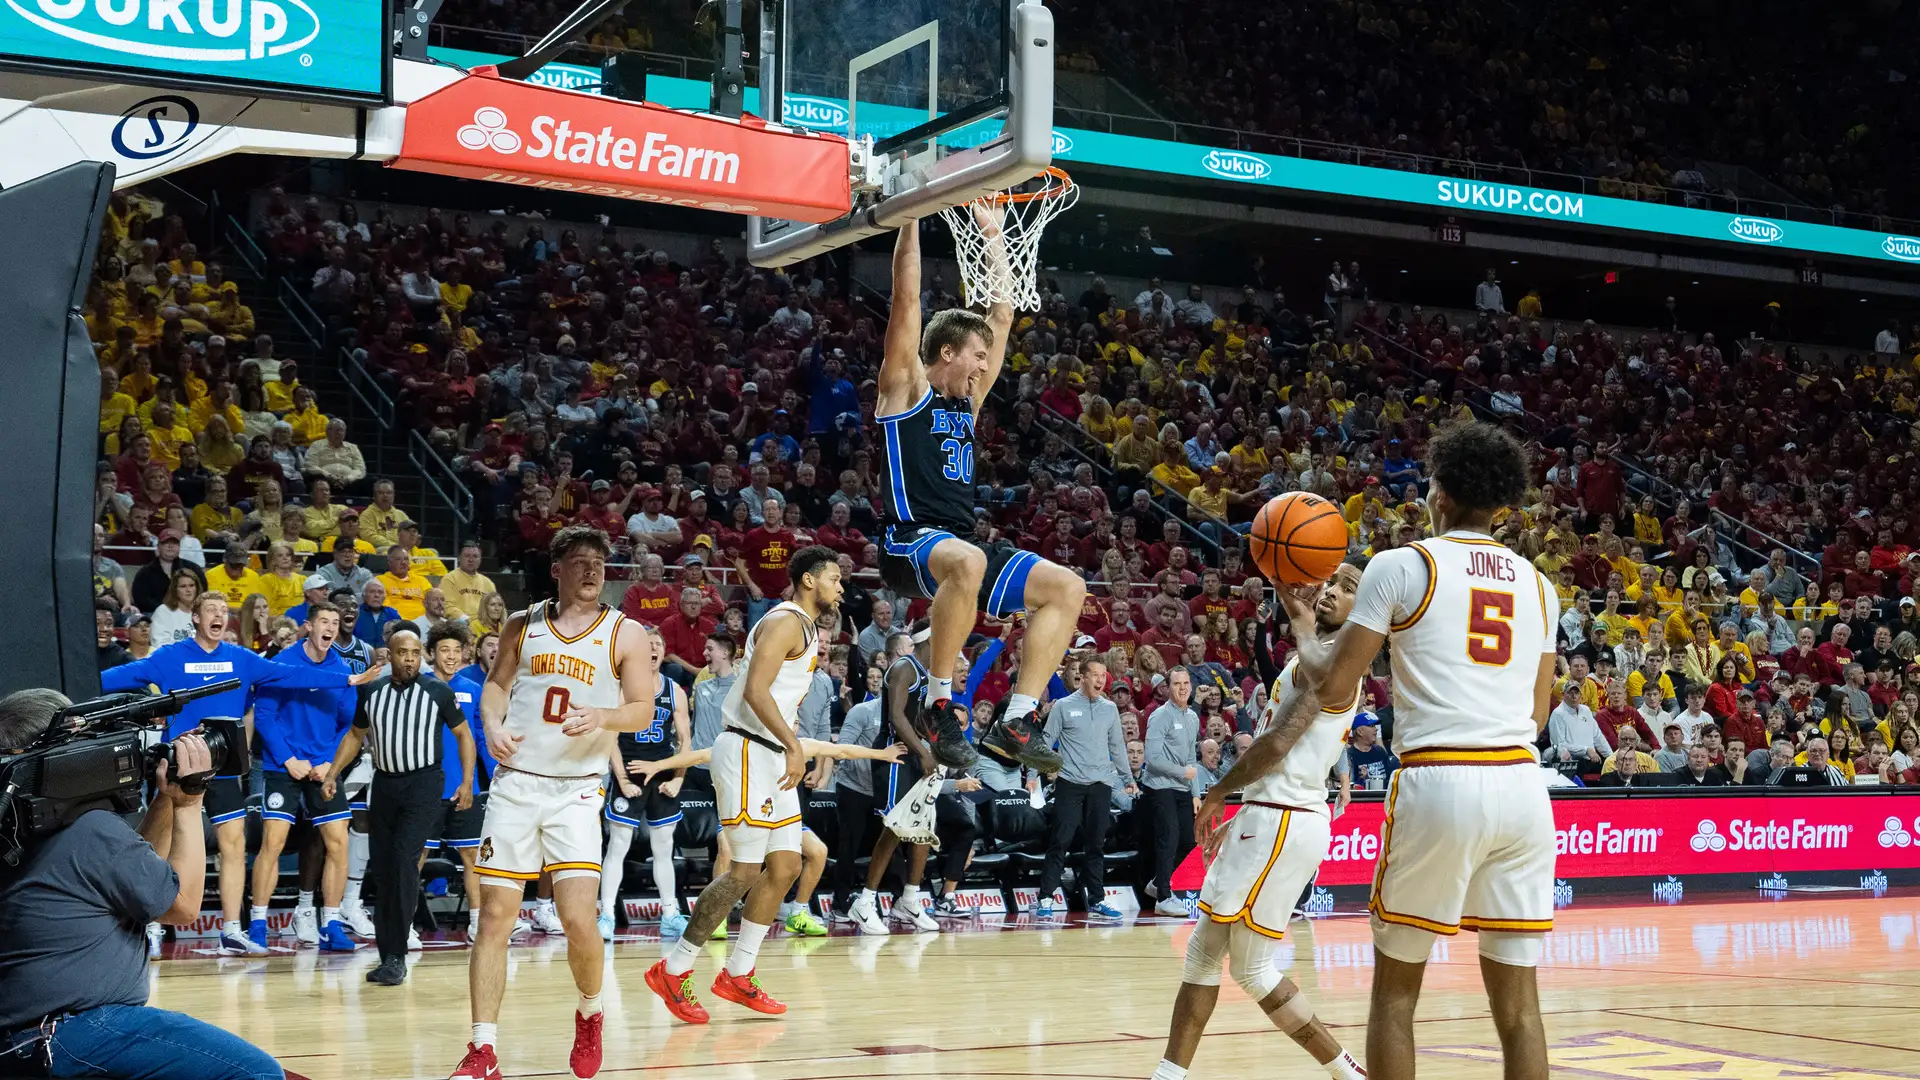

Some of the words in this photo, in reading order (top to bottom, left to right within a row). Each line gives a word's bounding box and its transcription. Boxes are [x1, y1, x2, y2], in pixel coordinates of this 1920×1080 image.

[1209, 150, 1264, 179] Sukup
[1437, 180, 1584, 218] SUKUP.COM
[1442, 228, 1461, 243] 113
[1733, 217, 1778, 242] Sukup
[1886, 236, 1920, 256] Suku
[1802, 270, 1818, 283] 114
[941, 438, 974, 484] 30
[1466, 550, 1516, 582] JONES
[1466, 587, 1515, 667] 5
[531, 652, 556, 676] IOWA
[557, 654, 596, 686] STATE
[542, 686, 571, 724] 0
[113, 743, 133, 752] ONY
[1795, 773, 1808, 782] POSS
[1653, 882, 1683, 892] LANDUS
[1759, 878, 1788, 888] LANDUS
[1860, 876, 1888, 886] LANDUS
